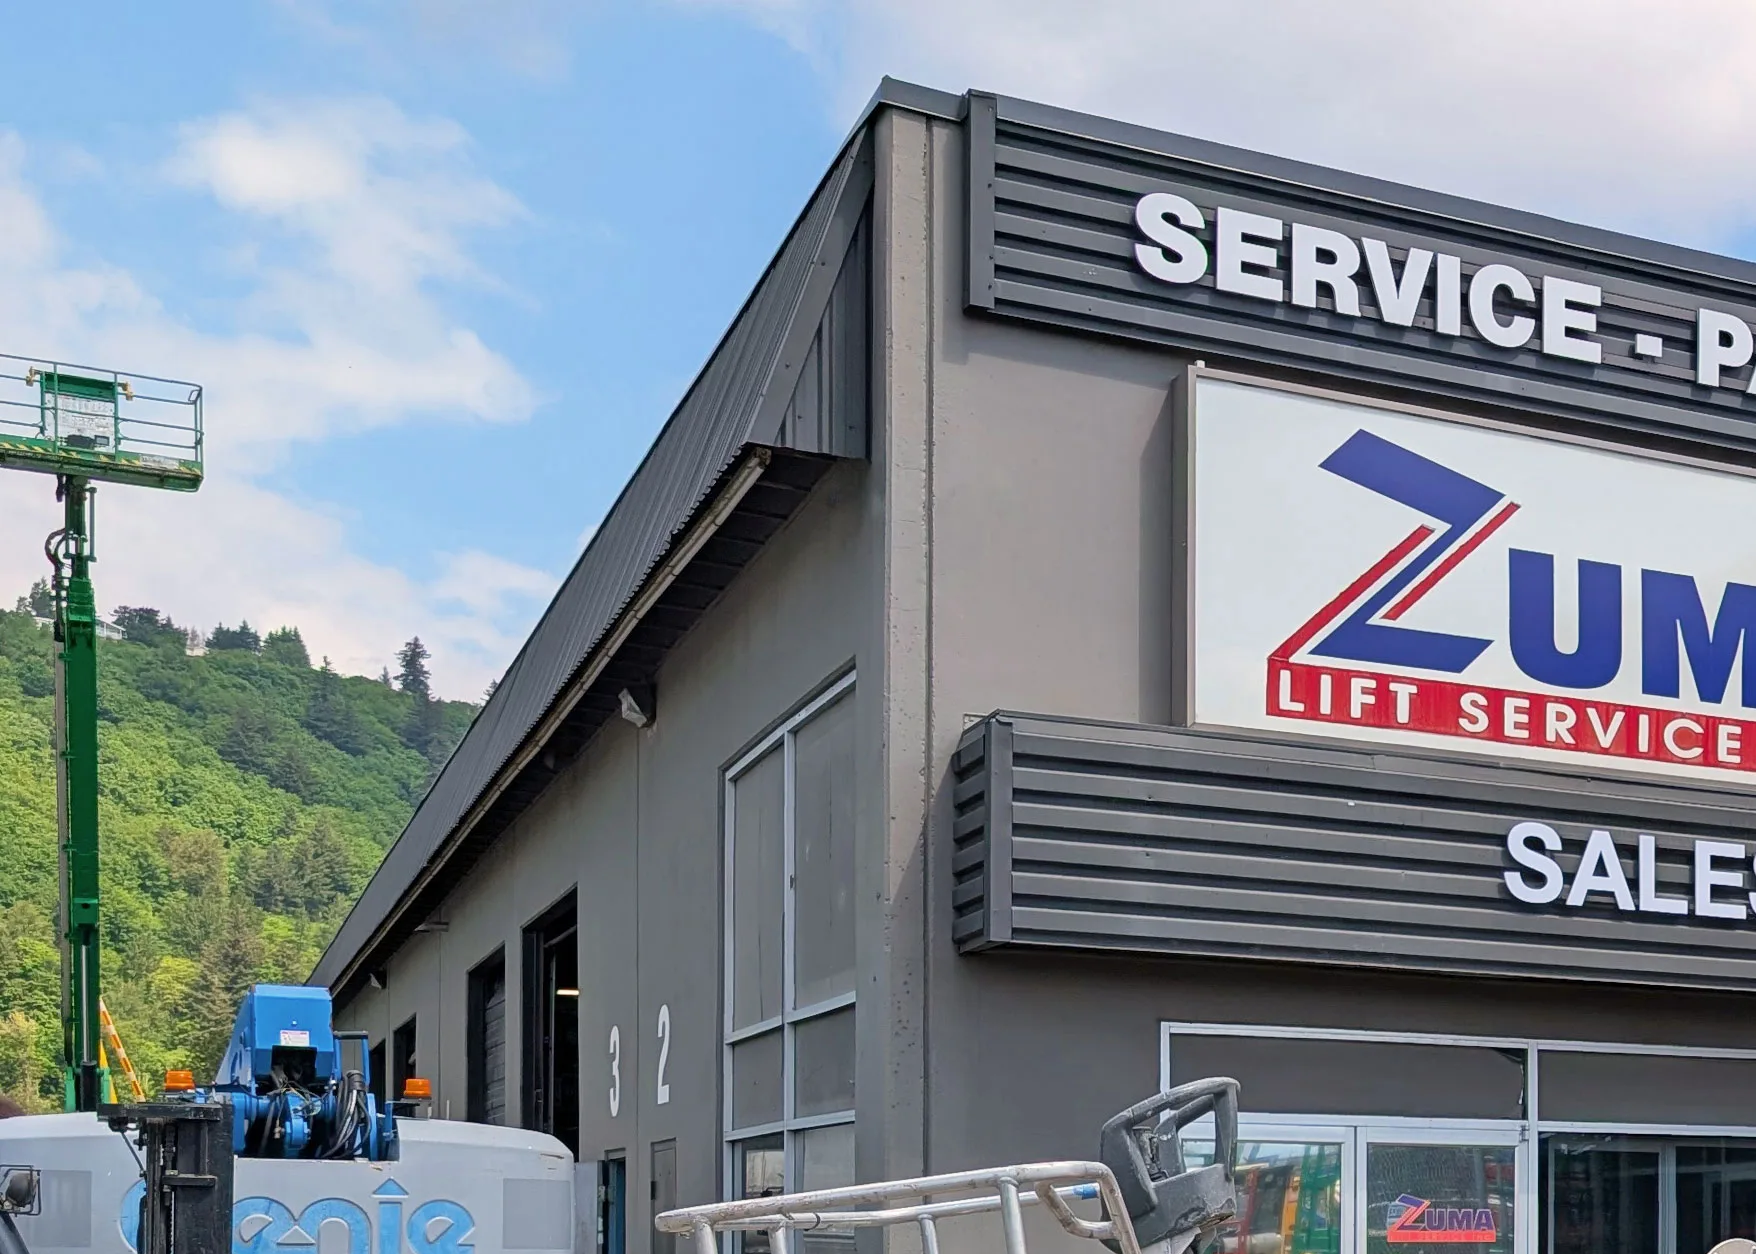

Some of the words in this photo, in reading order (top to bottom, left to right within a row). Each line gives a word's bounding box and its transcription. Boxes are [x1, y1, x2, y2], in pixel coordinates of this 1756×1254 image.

[1134, 191, 1603, 365] SERVICE
[1635, 332, 1664, 358] -
[1278, 669, 1418, 724] LIFT
[1458, 691, 1742, 765] SERVICE
[609, 1024, 620, 1118] 3
[657, 1003, 670, 1105] 2
[1388, 1193, 1496, 1232] ZUMA
